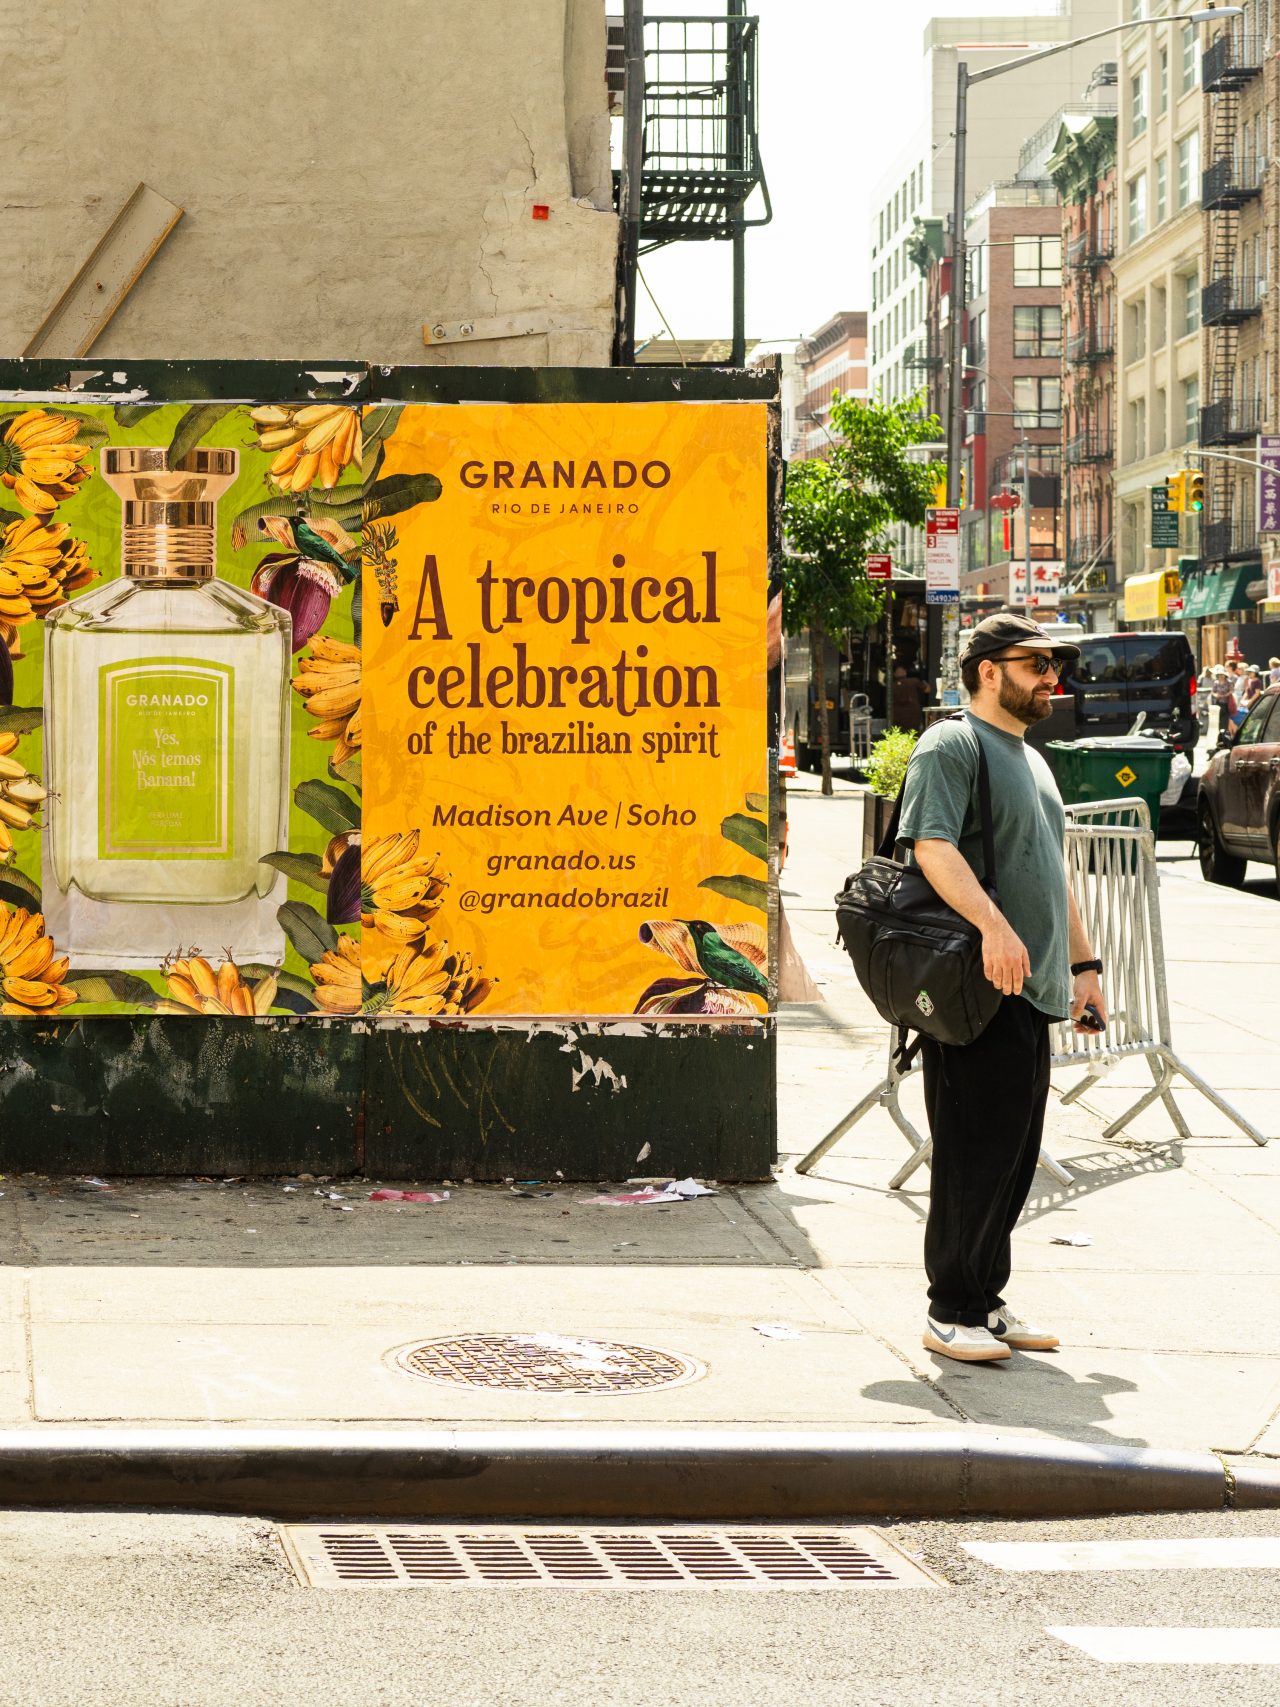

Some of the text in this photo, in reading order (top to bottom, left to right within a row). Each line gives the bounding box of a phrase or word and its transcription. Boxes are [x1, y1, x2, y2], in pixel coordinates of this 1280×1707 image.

[460, 461, 671, 489] GRANADO
[492, 503, 639, 514] RIO DE JANEIRO
[408, 552, 720, 644] A tropical
[408, 643, 720, 716] celebration
[127, 695, 208, 706] GRANADO
[408, 721, 720, 763] of the brazilian spirit
[133, 750, 201, 769] Nós temos
[138, 770, 196, 790] Banana!
[432, 804, 550, 827] Madison
[557, 805, 608, 826] Ave
[627, 804, 696, 826] Soho
[487, 850, 635, 876] granado.us
[459, 887, 669, 914] @granadobrazil
